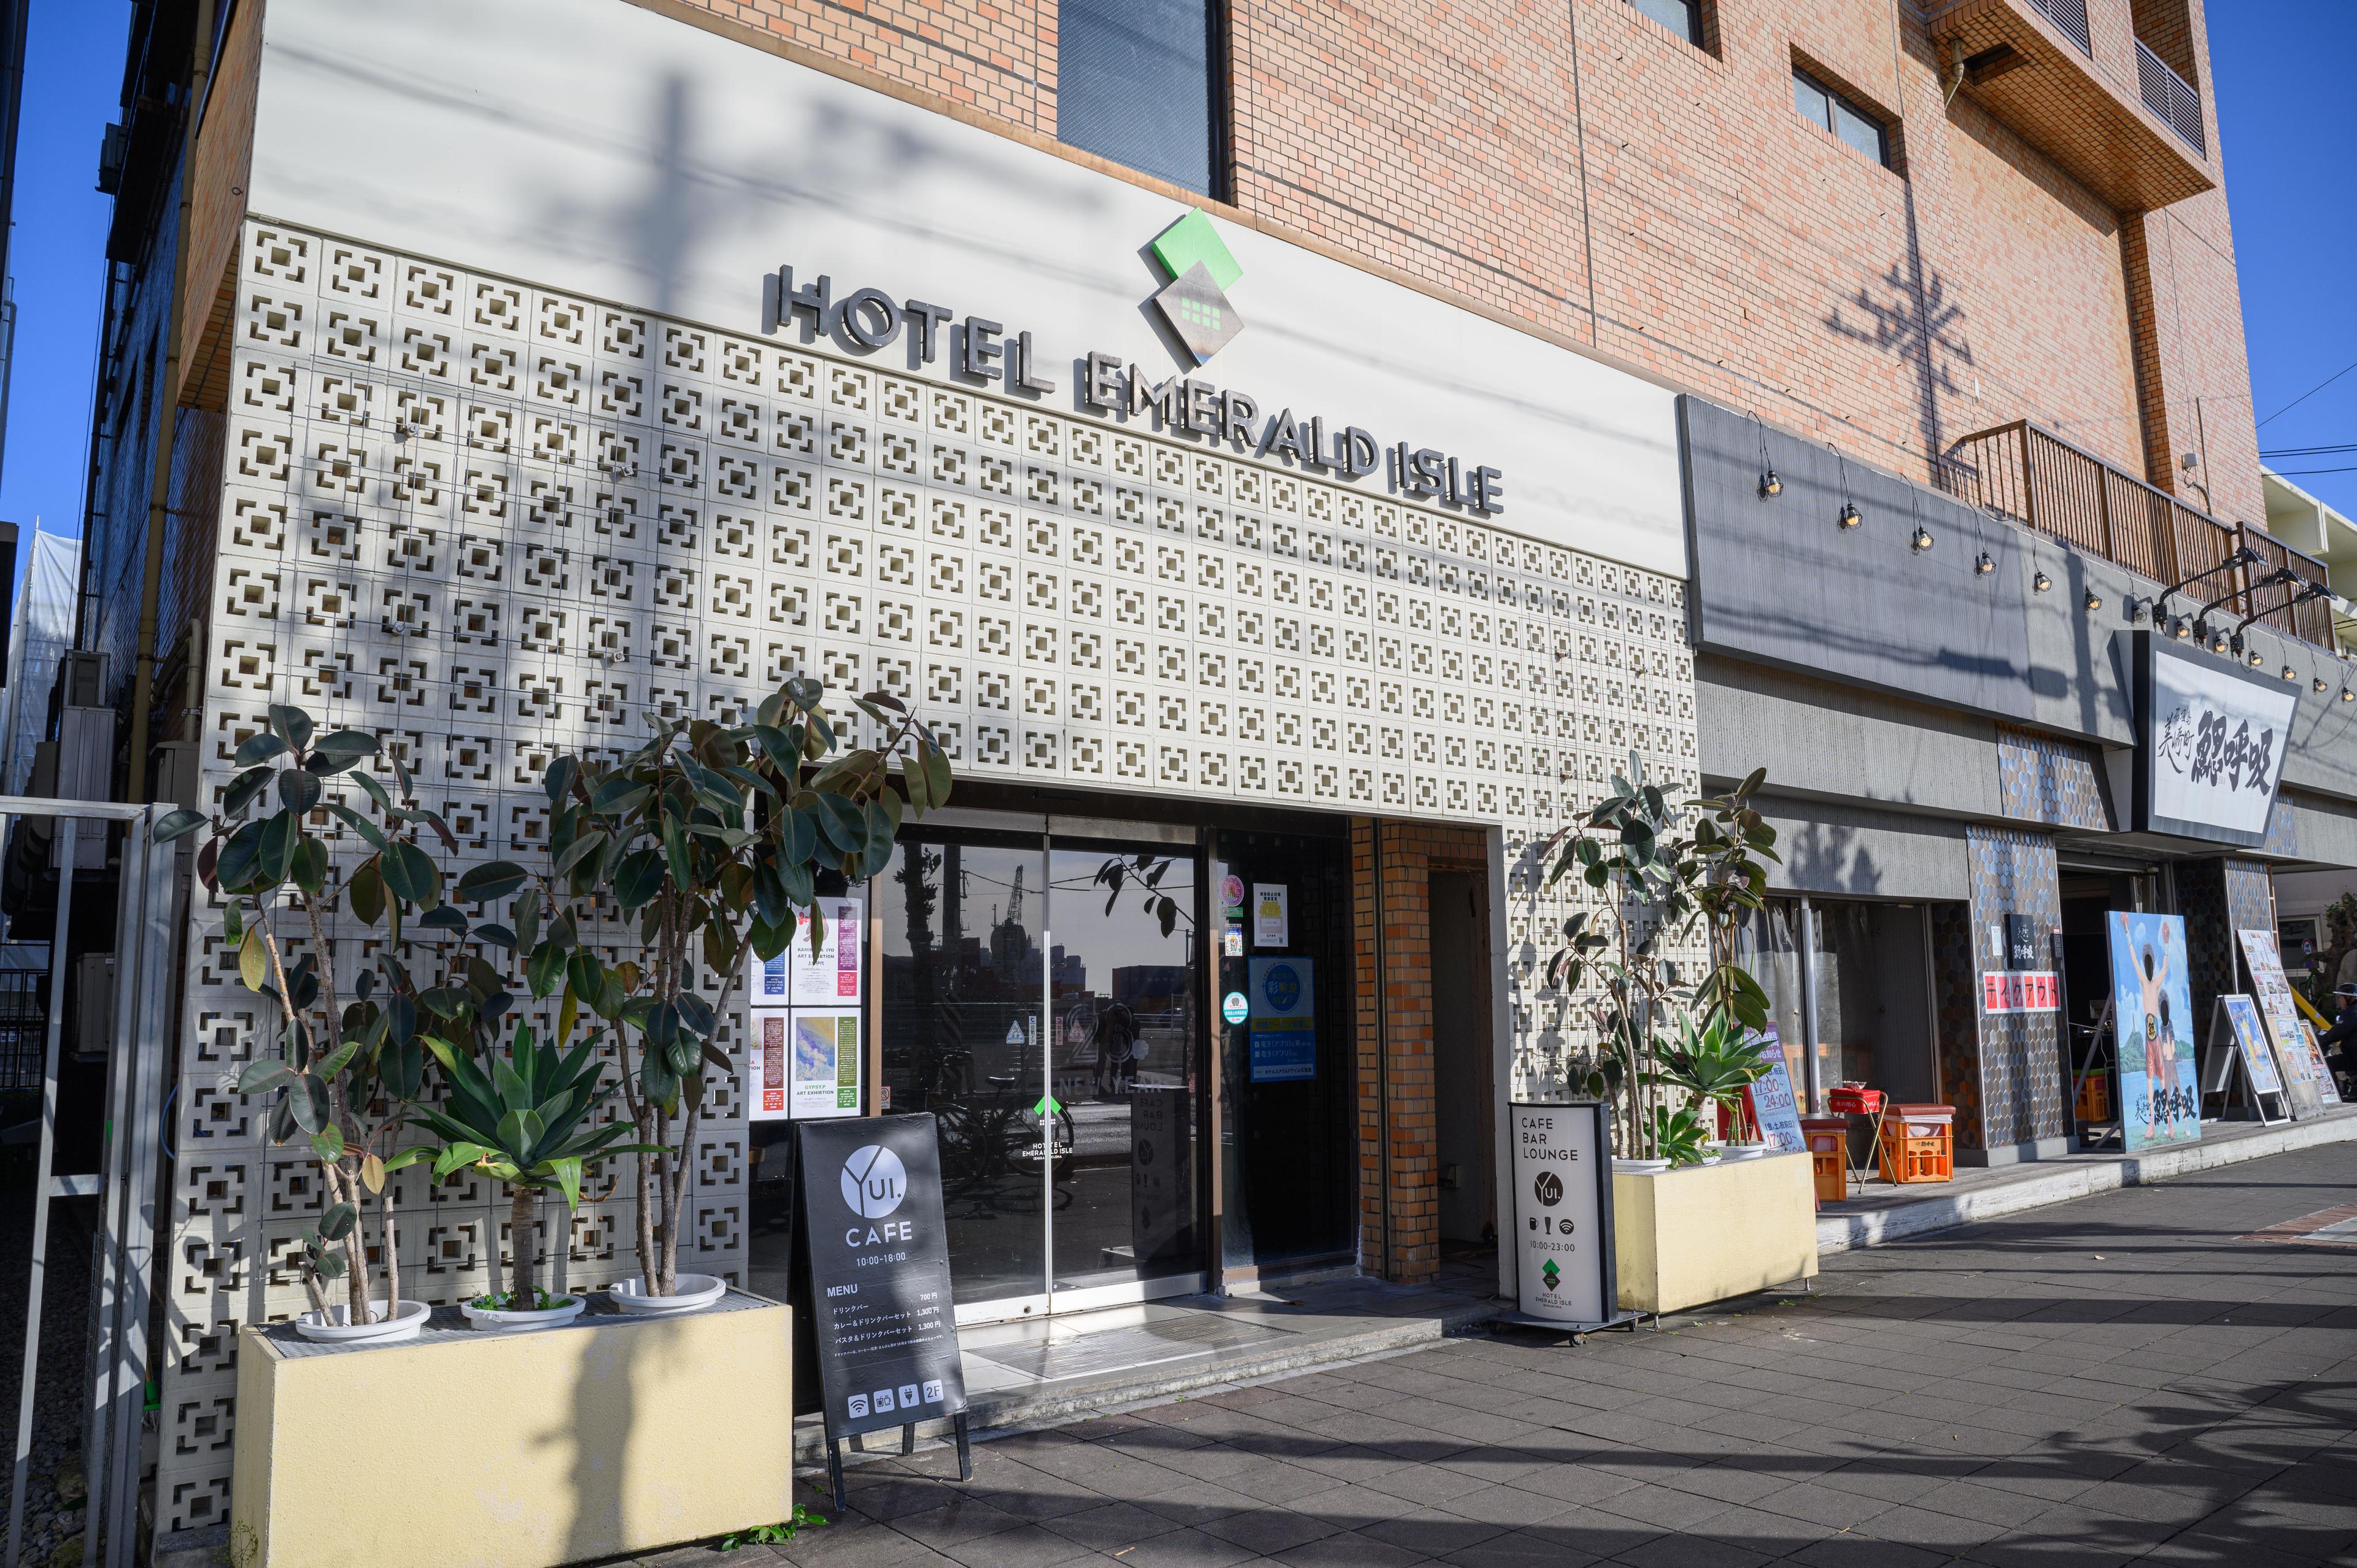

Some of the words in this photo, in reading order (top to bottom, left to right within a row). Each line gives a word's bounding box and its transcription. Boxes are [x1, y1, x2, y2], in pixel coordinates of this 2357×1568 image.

[777, 263, 1056, 394] HOTEL
[1086, 350, 1380, 477] EMERALD
[1398, 441, 1504, 515] ISLE
[1986, 982, 2057, 1002] テイクアウト
[1110, 1075, 1162, 1094] YEAR
[1764, 1093, 1791, 1108] 24:00
[1522, 1117, 1553, 1130] CAFE
[1523, 1132, 1547, 1145] BAR
[1523, 1148, 1578, 1161] LOUNGE
[846, 1221, 912, 1248] CAFE
[1530, 1240, 1575, 1252] 10:00-23:00
[857, 1252, 906, 1267] 10:00-18:00
[827, 1283, 858, 1297] MENU
[1535, 1296, 1558, 1305] EMERALD
[834, 1304, 869, 1315] ドリンクバー
[927, 1385, 940, 1398] 2F
